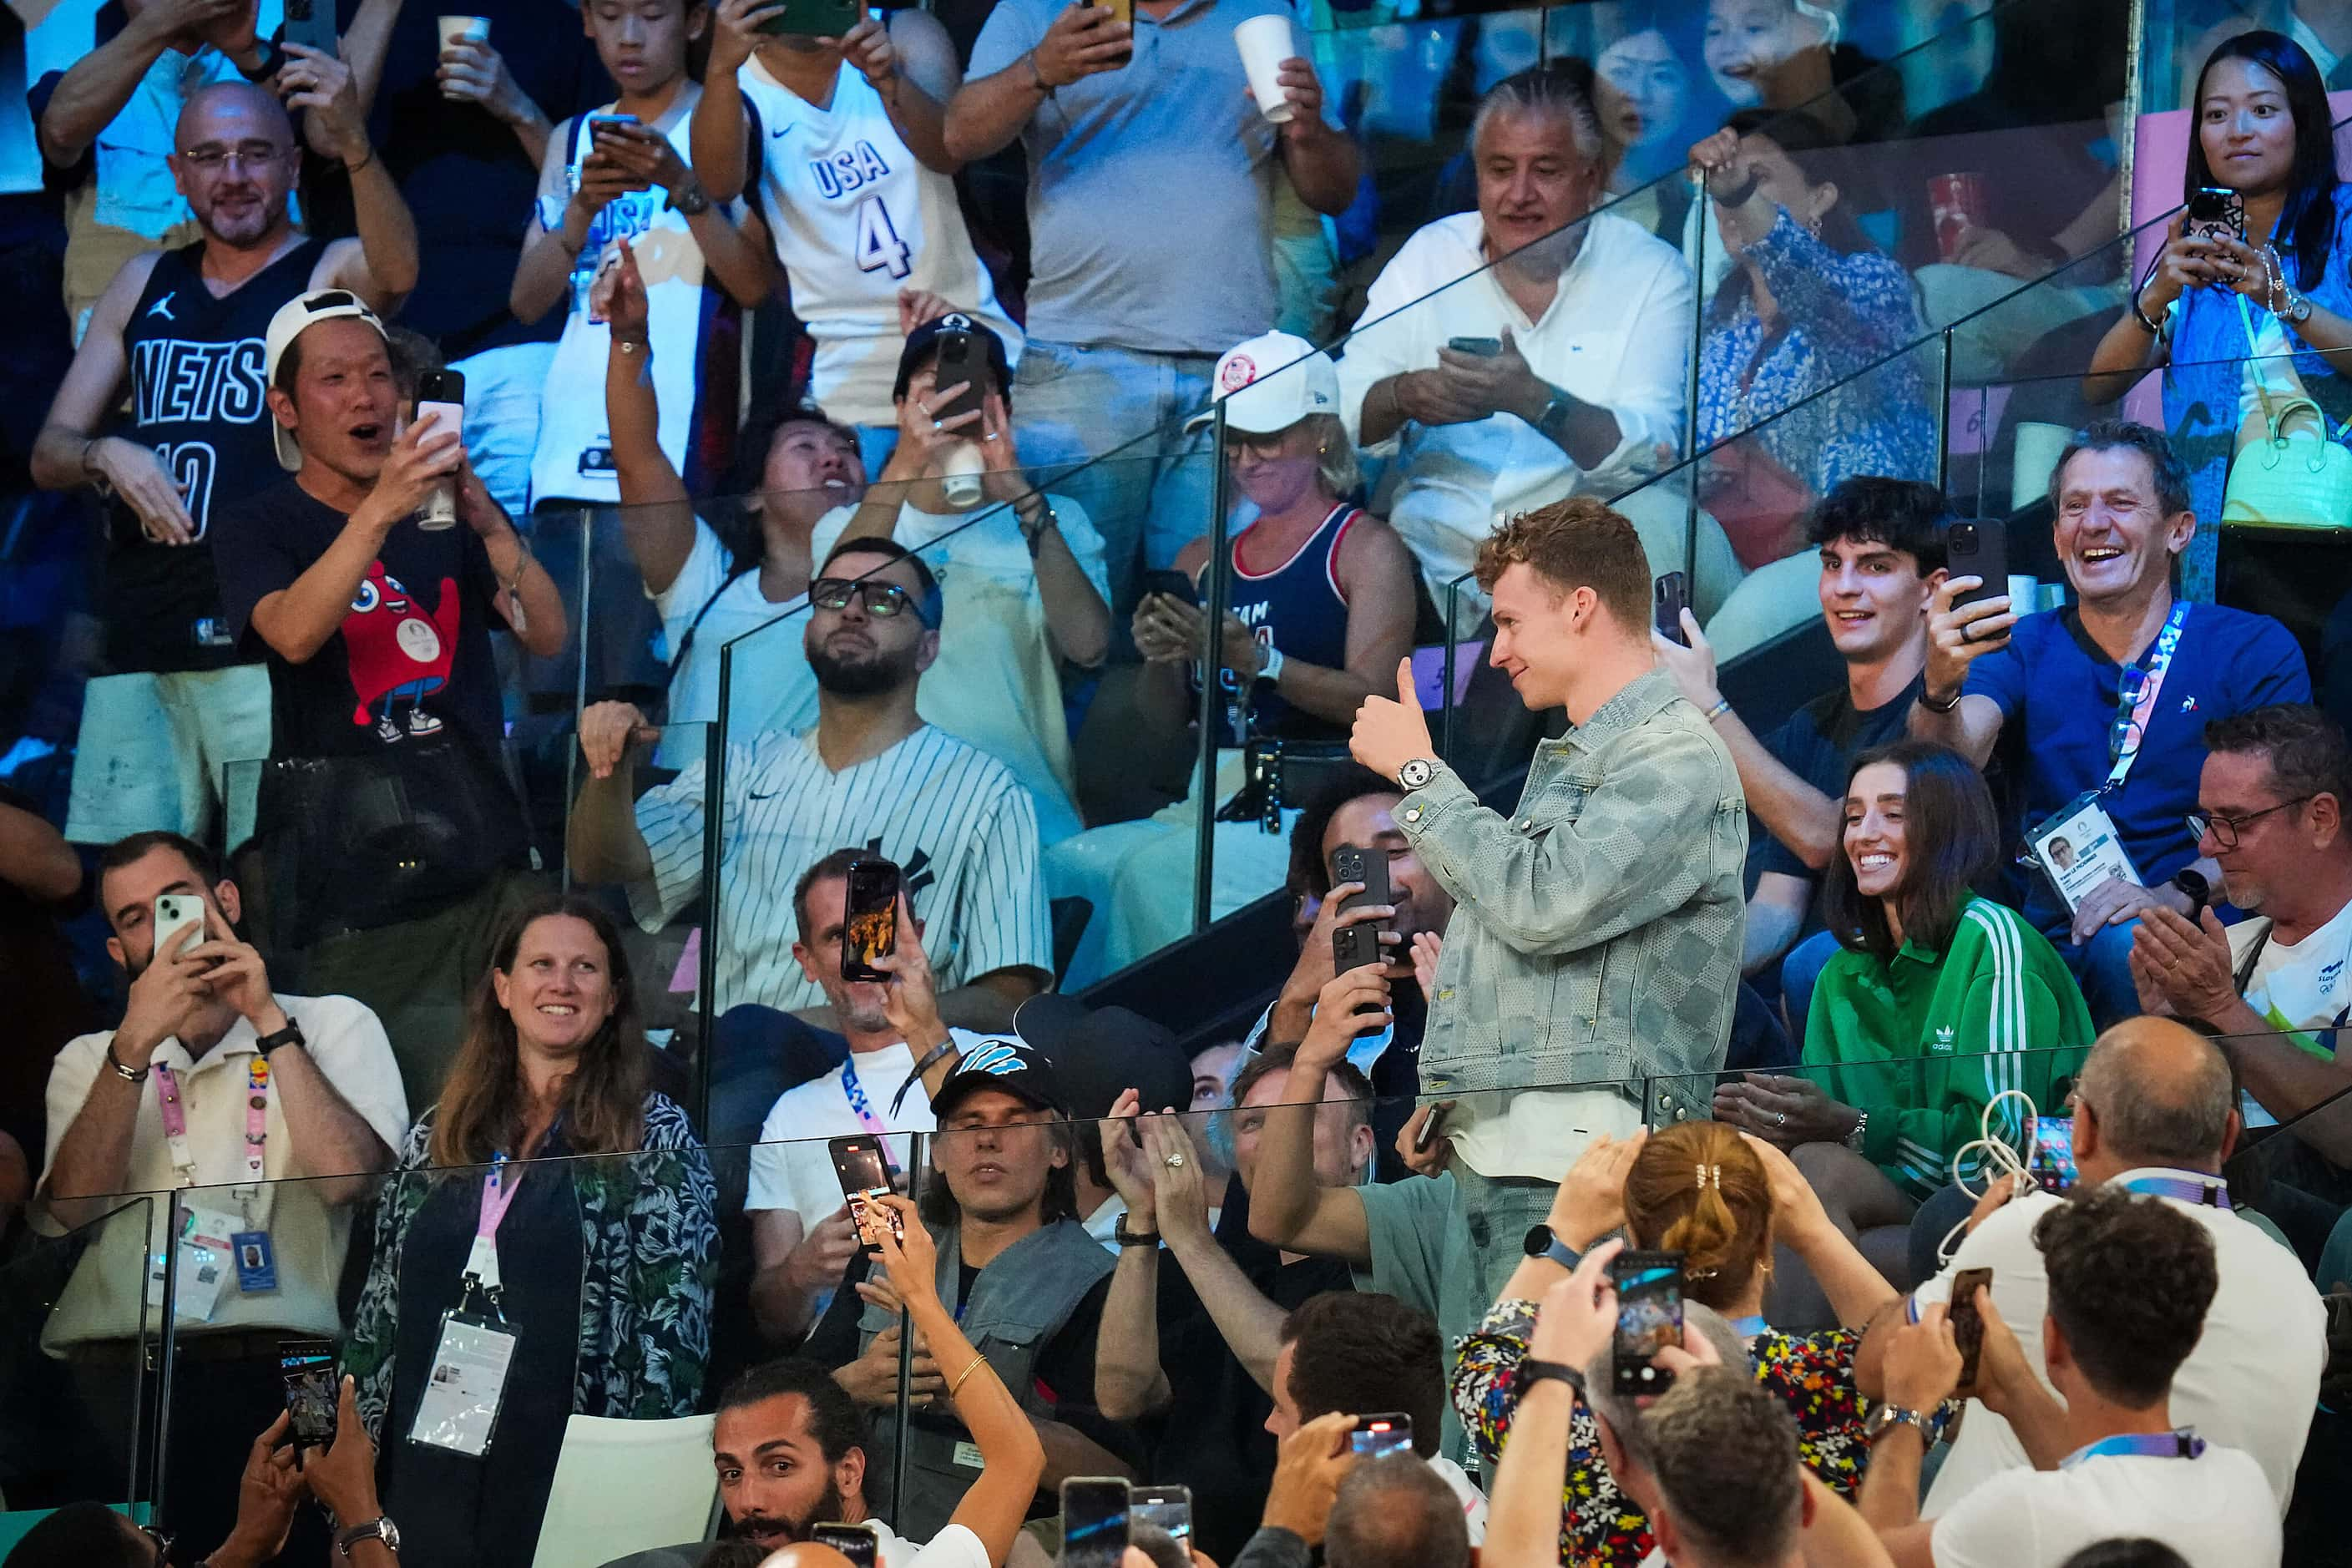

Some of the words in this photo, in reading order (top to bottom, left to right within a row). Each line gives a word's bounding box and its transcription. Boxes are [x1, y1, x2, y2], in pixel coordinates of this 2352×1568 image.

[808, 139, 890, 199] USA
[856, 193, 911, 280] 4
[131, 337, 267, 427] NETS
